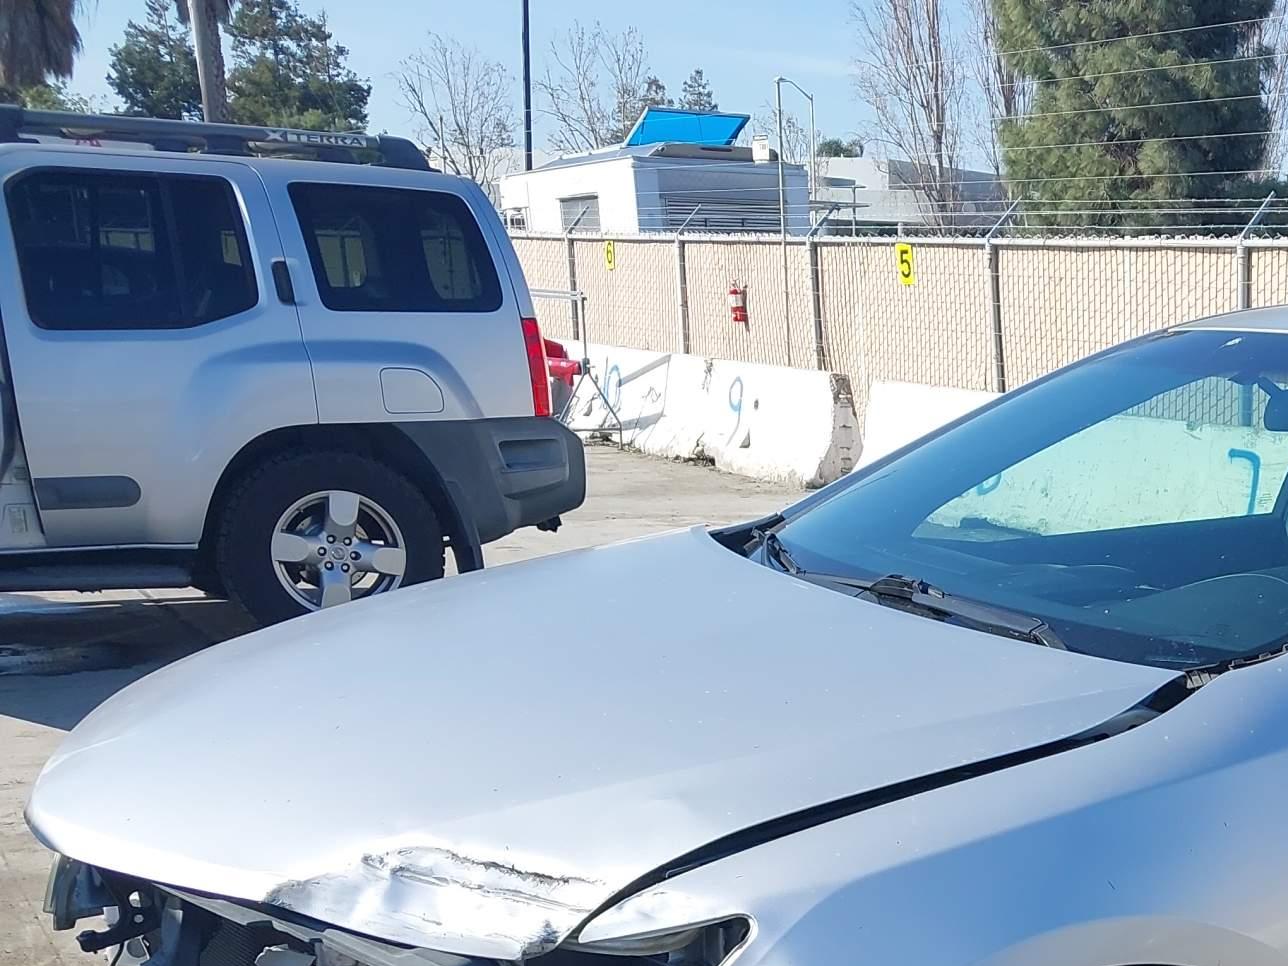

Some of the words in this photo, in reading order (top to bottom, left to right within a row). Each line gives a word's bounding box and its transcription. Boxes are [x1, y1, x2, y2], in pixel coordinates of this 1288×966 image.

[264, 130, 366, 147] XTERRA
[607, 241, 613, 264] 6
[900, 250, 911, 278] 5
[728, 376, 744, 447] 9
